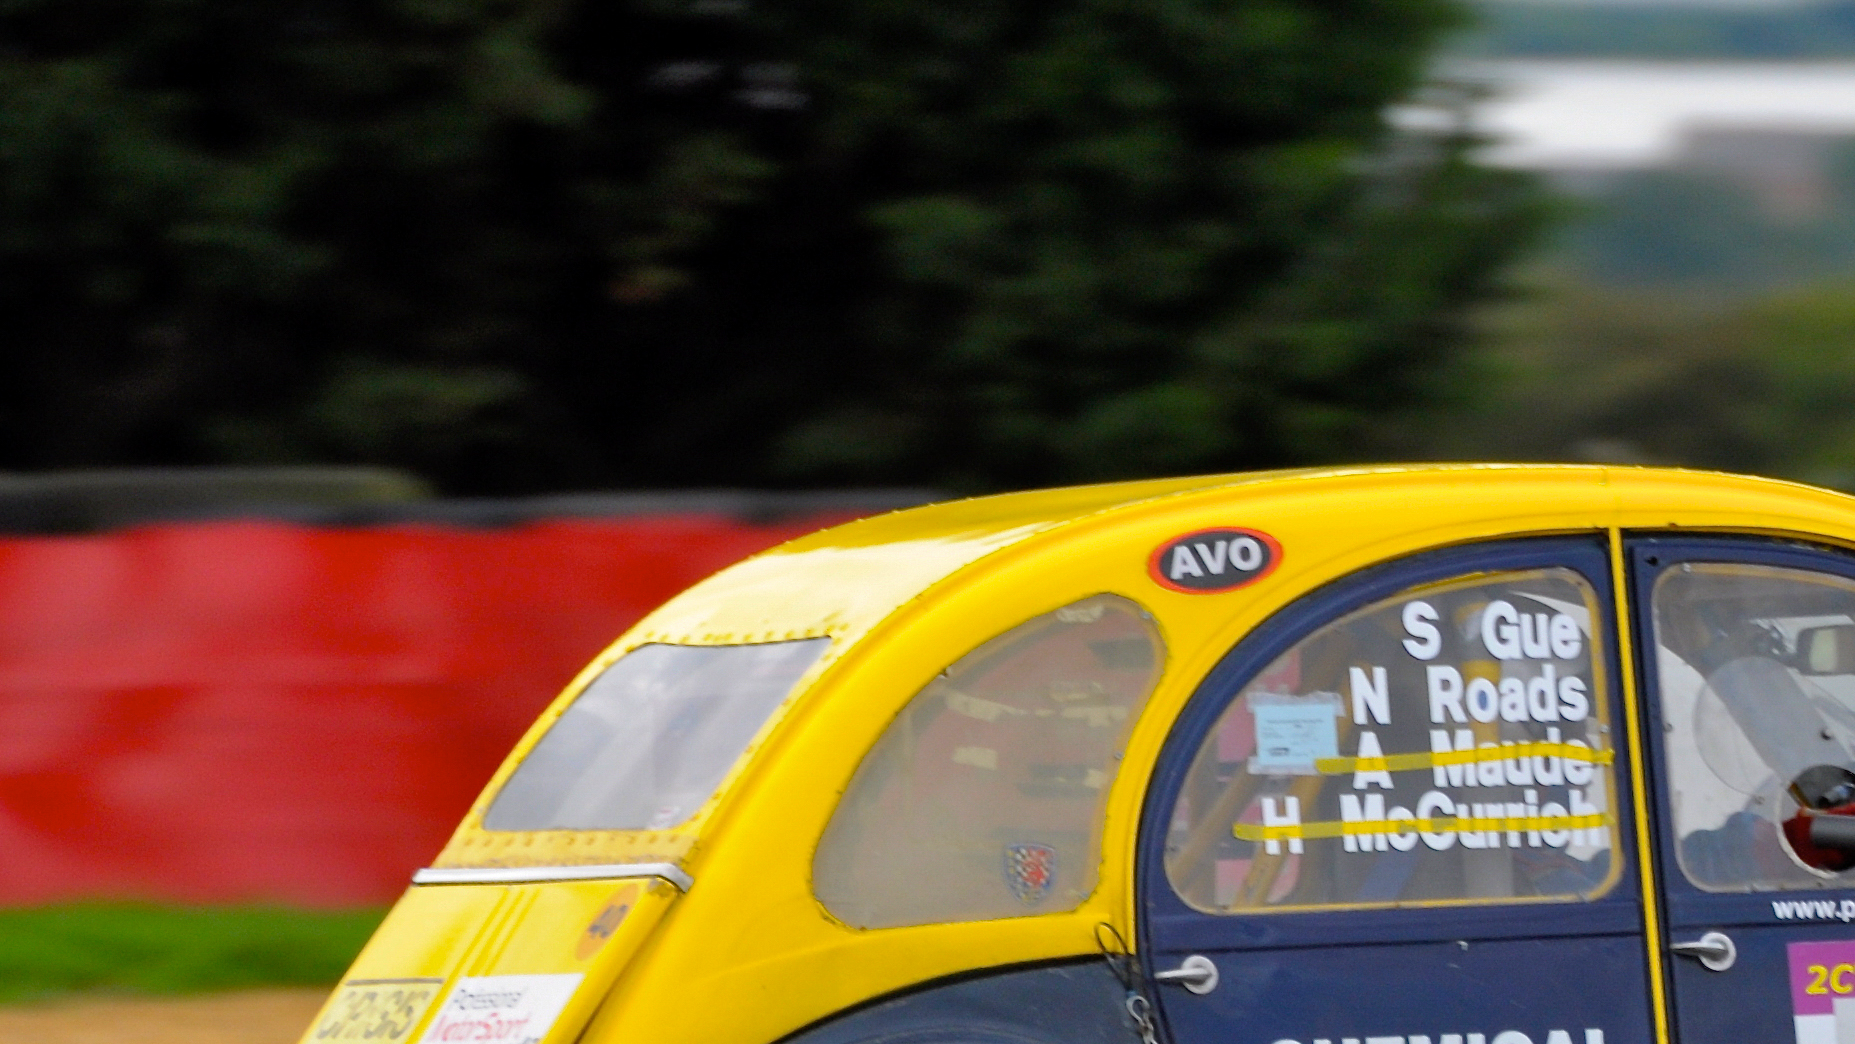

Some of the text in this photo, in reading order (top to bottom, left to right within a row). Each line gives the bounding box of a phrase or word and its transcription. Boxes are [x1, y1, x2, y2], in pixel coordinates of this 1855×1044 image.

[1169, 537, 1263, 581] AVO
[1401, 600, 1582, 661] S Gue
[1349, 664, 1589, 725] N Roads
[1352, 731, 1394, 790] A
[1429, 728, 1595, 787] Maude
[1261, 796, 1303, 855] H
